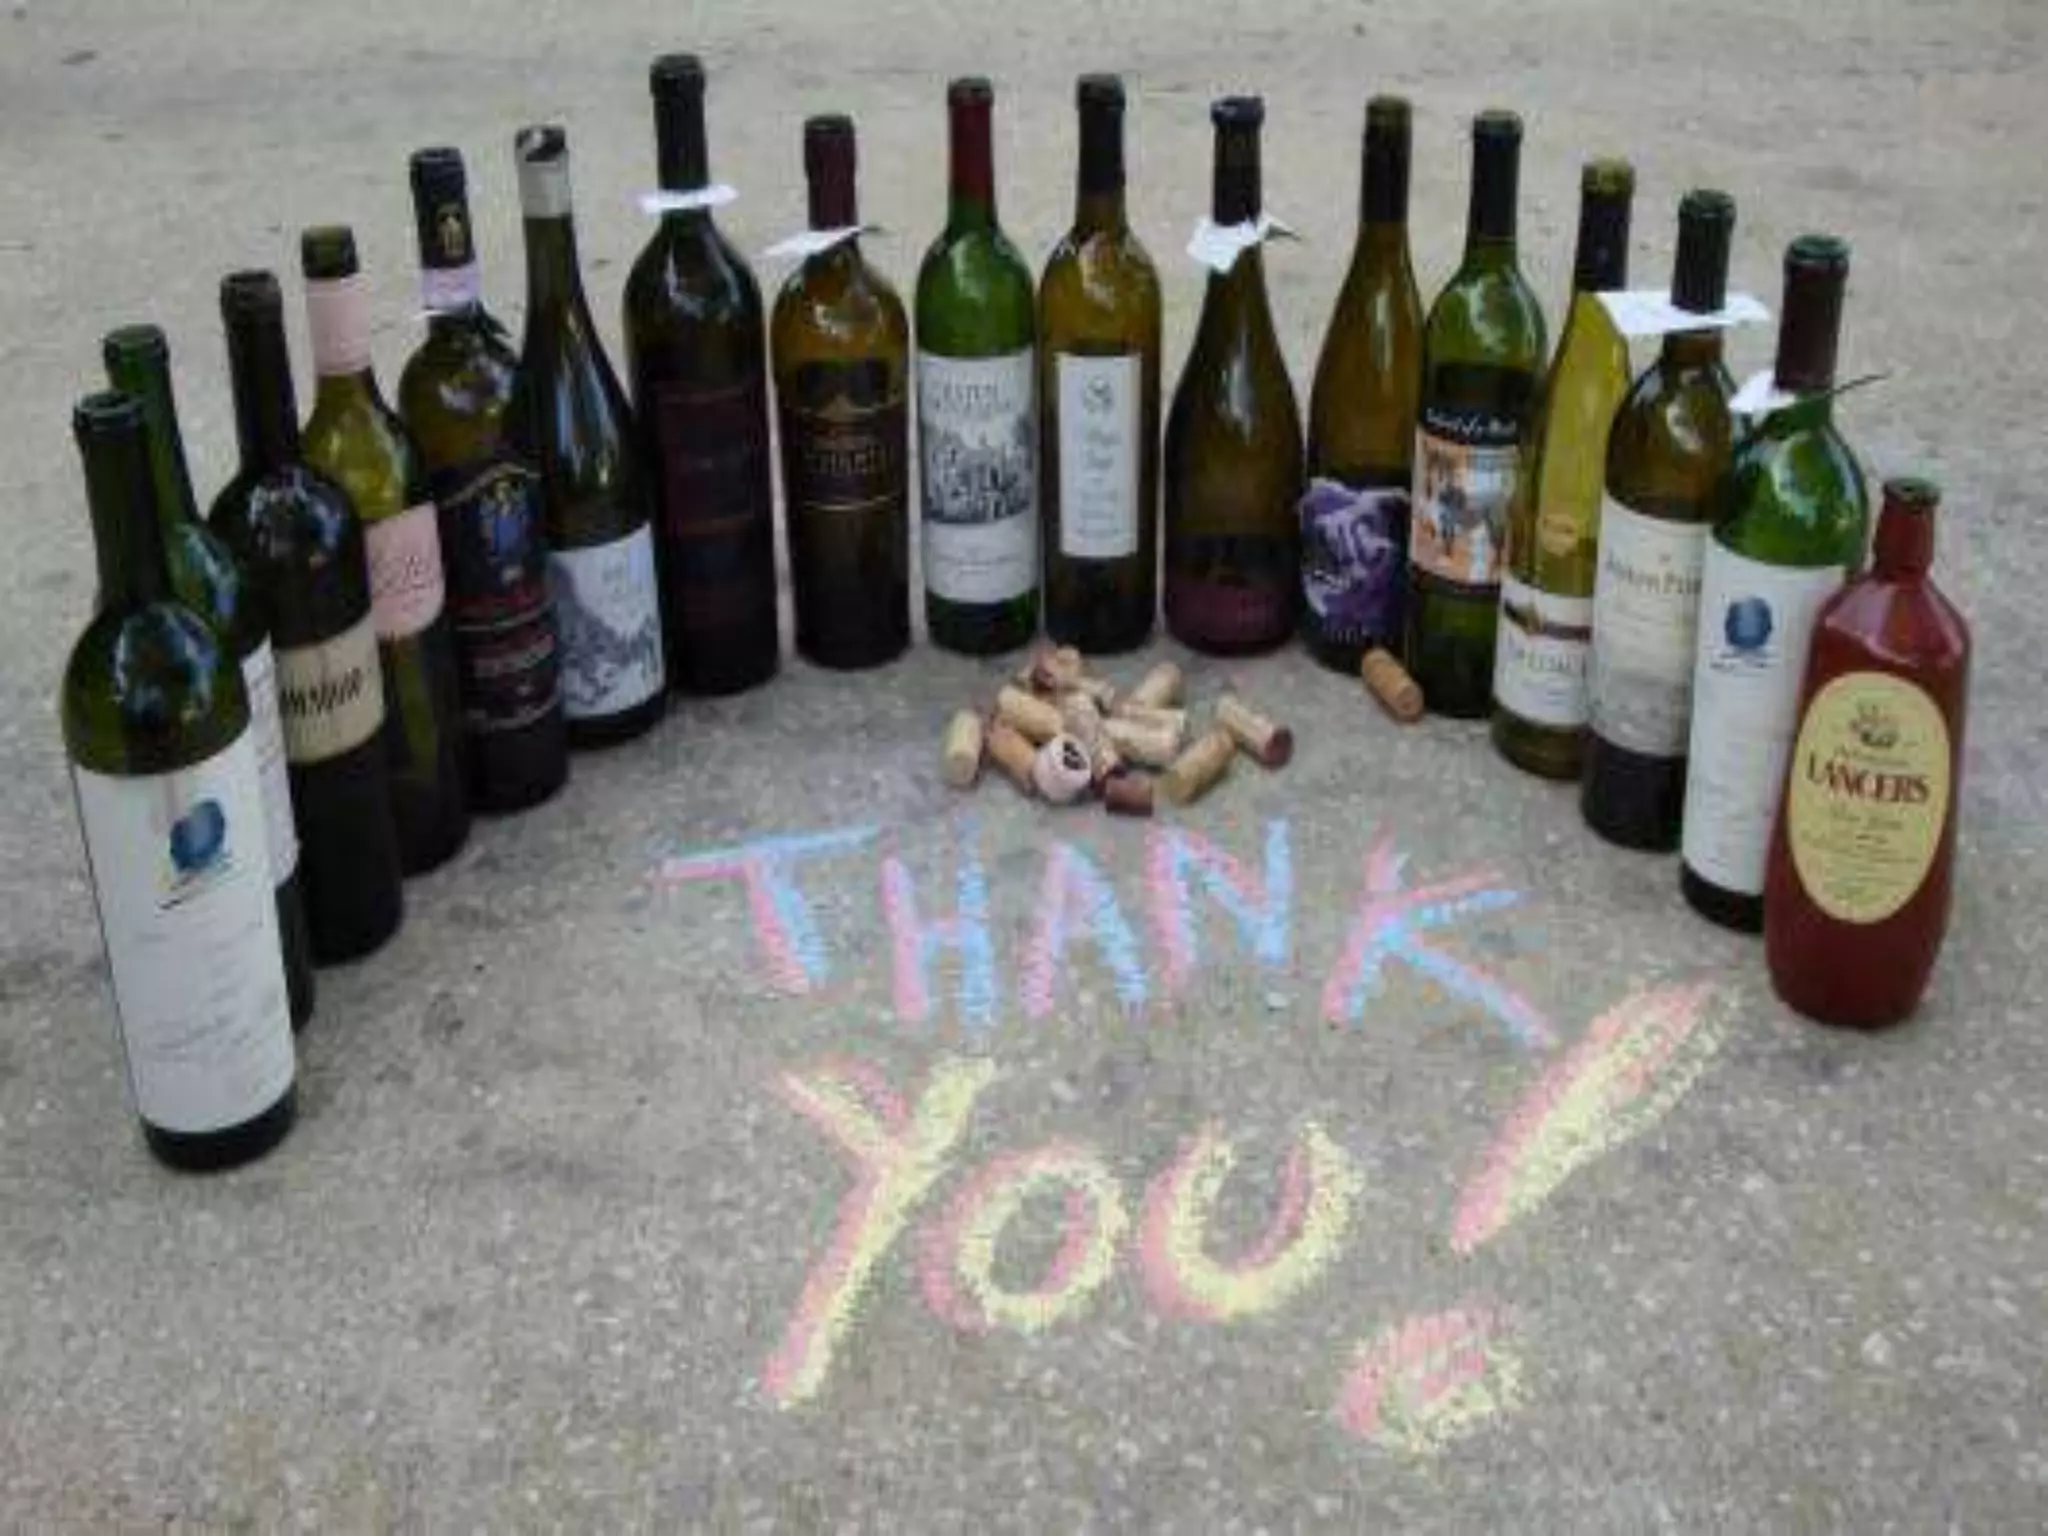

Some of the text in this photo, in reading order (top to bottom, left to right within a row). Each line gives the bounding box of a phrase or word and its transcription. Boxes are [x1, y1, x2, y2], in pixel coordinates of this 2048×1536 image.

[1806, 751, 1931, 803] LANCERS
[660, 817, 1555, 1046] THANK
[762, 982, 1734, 1447] YOU!
